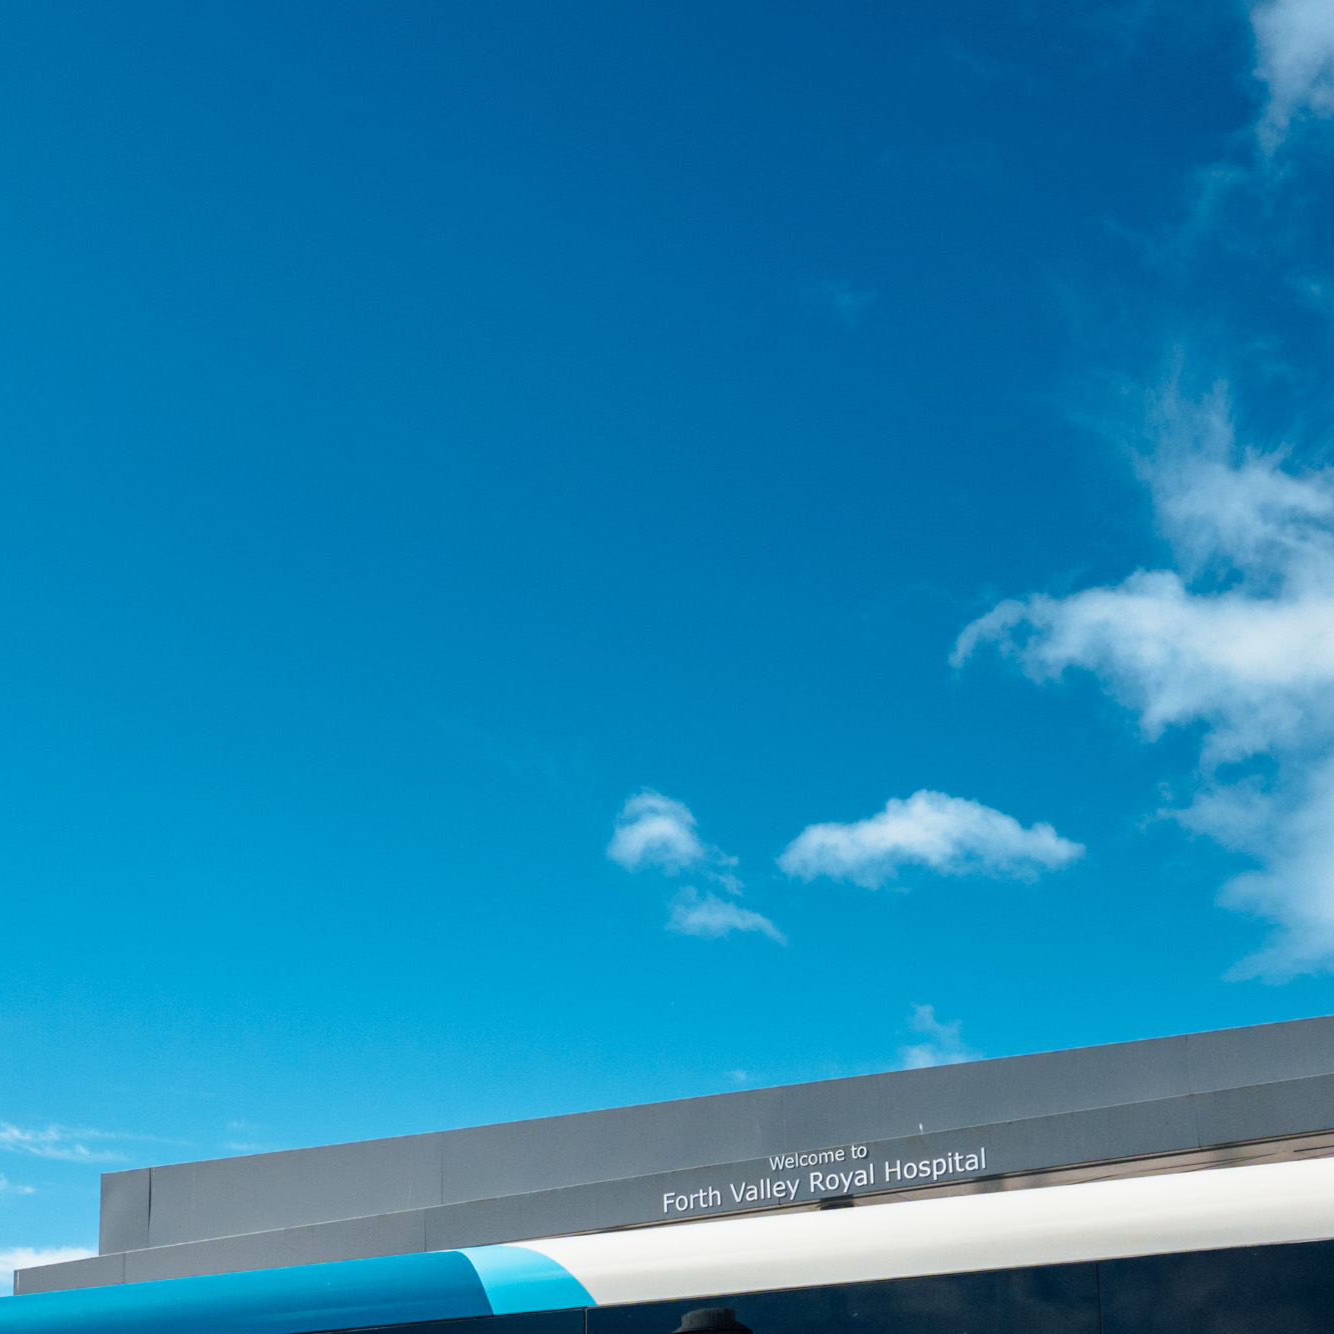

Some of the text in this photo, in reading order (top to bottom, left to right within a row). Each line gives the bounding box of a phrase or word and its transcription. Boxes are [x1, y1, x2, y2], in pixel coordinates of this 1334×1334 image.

[663, 1147, 987, 1213] Forth Valley Royal Hospital
[769, 1145, 867, 1171] Welcome to
